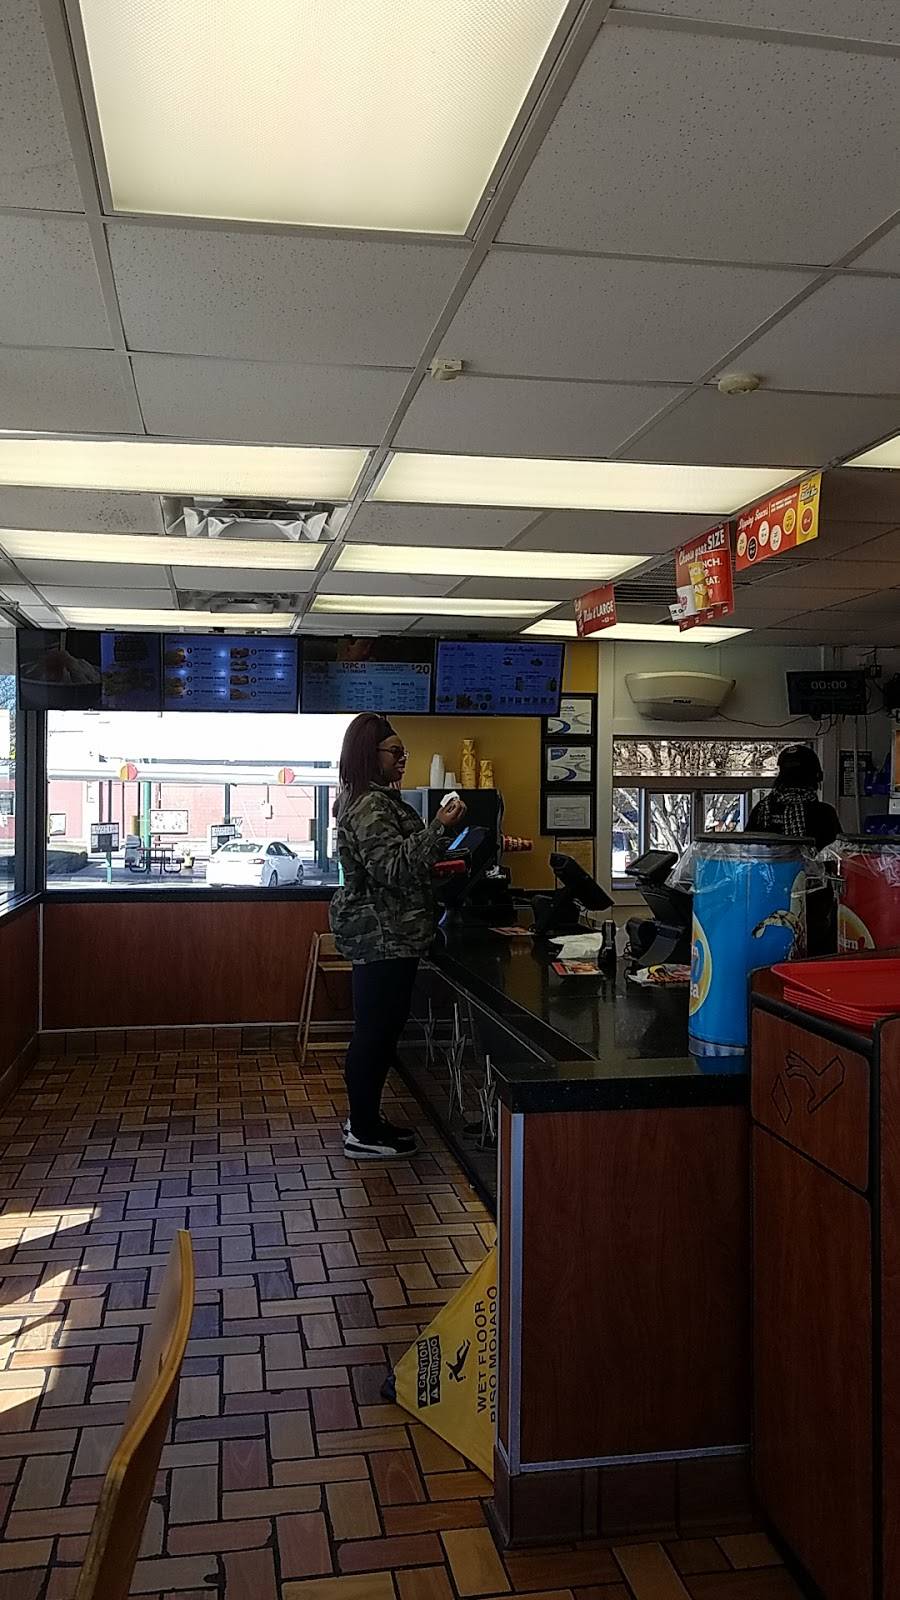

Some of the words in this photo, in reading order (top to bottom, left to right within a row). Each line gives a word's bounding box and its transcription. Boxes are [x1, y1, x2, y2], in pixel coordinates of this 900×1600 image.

[707, 528, 725, 551] SIZE
[596, 600, 614, 617] LARGE
[810, 680, 847, 690] 00:00
[474, 1300, 488, 1365] FLOOR
[487, 1286, 498, 1369] MOJADO
[418, 1340, 429, 1388] CAUTION
[429, 1338, 440, 1385] CUIDADO
[477, 1371, 488, 1414] WET
